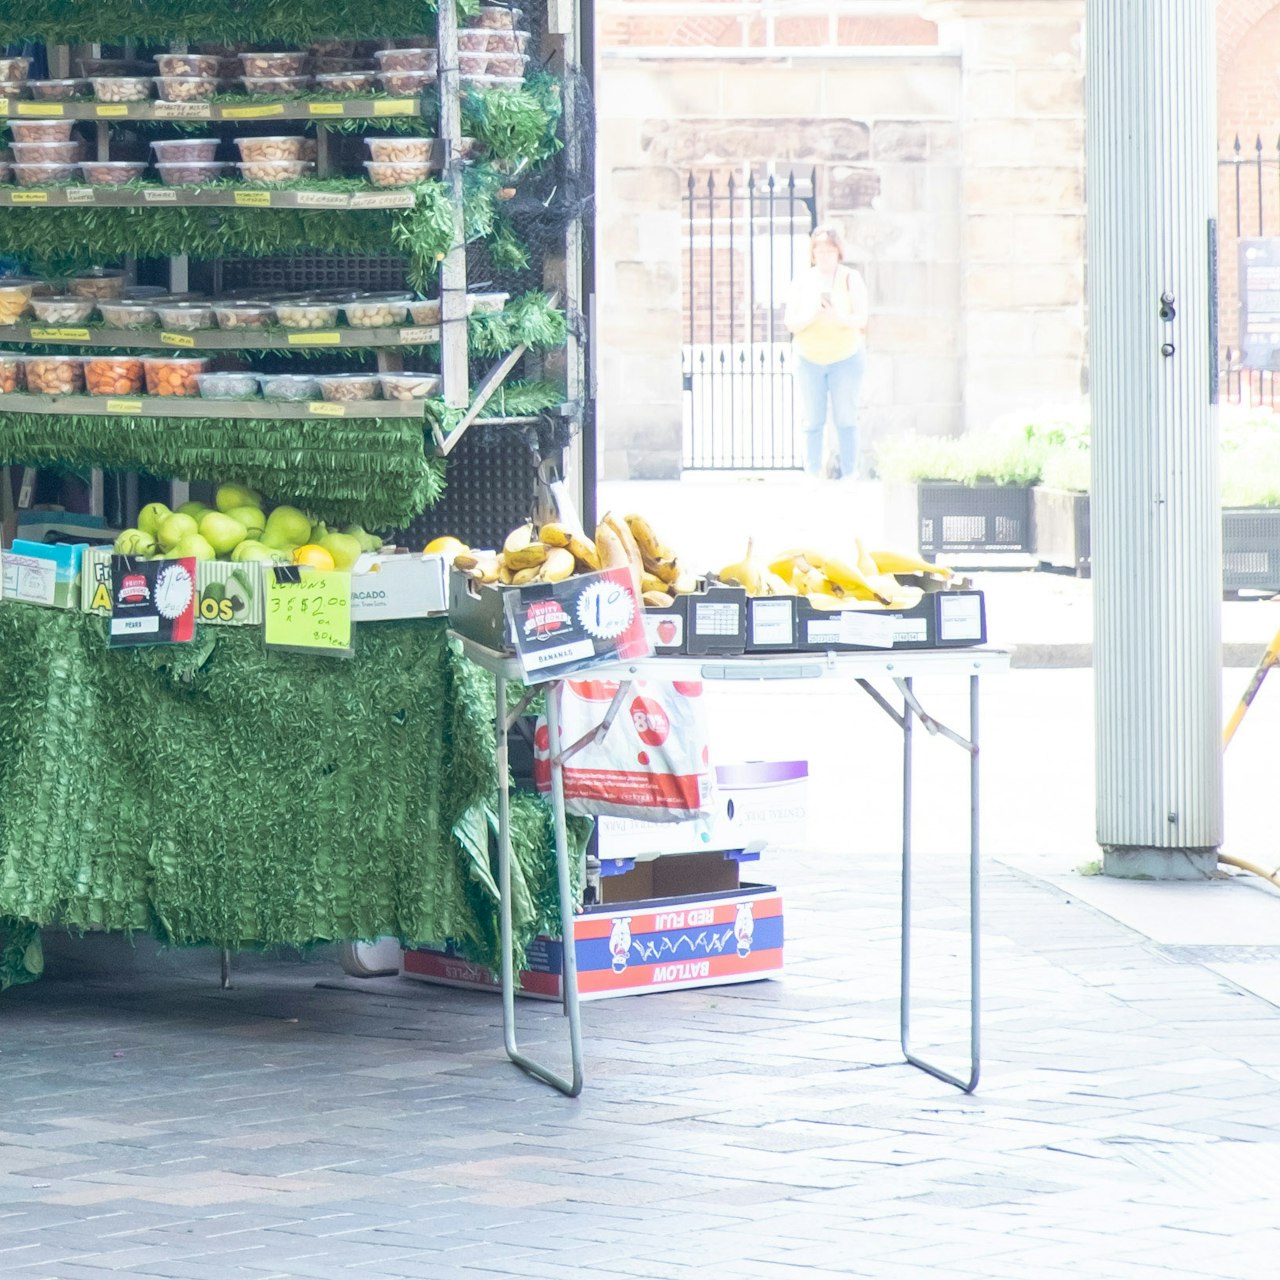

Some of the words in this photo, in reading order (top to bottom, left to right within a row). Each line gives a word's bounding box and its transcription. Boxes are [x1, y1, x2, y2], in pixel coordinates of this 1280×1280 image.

[271, 598, 281, 613] 3
[124, 621, 142, 629] PEARS
[538, 649, 573, 662] BANANAS
[654, 911, 685, 931] FUJI
[687, 908, 715, 926] RED
[652, 960, 710, 983] BATLOW
